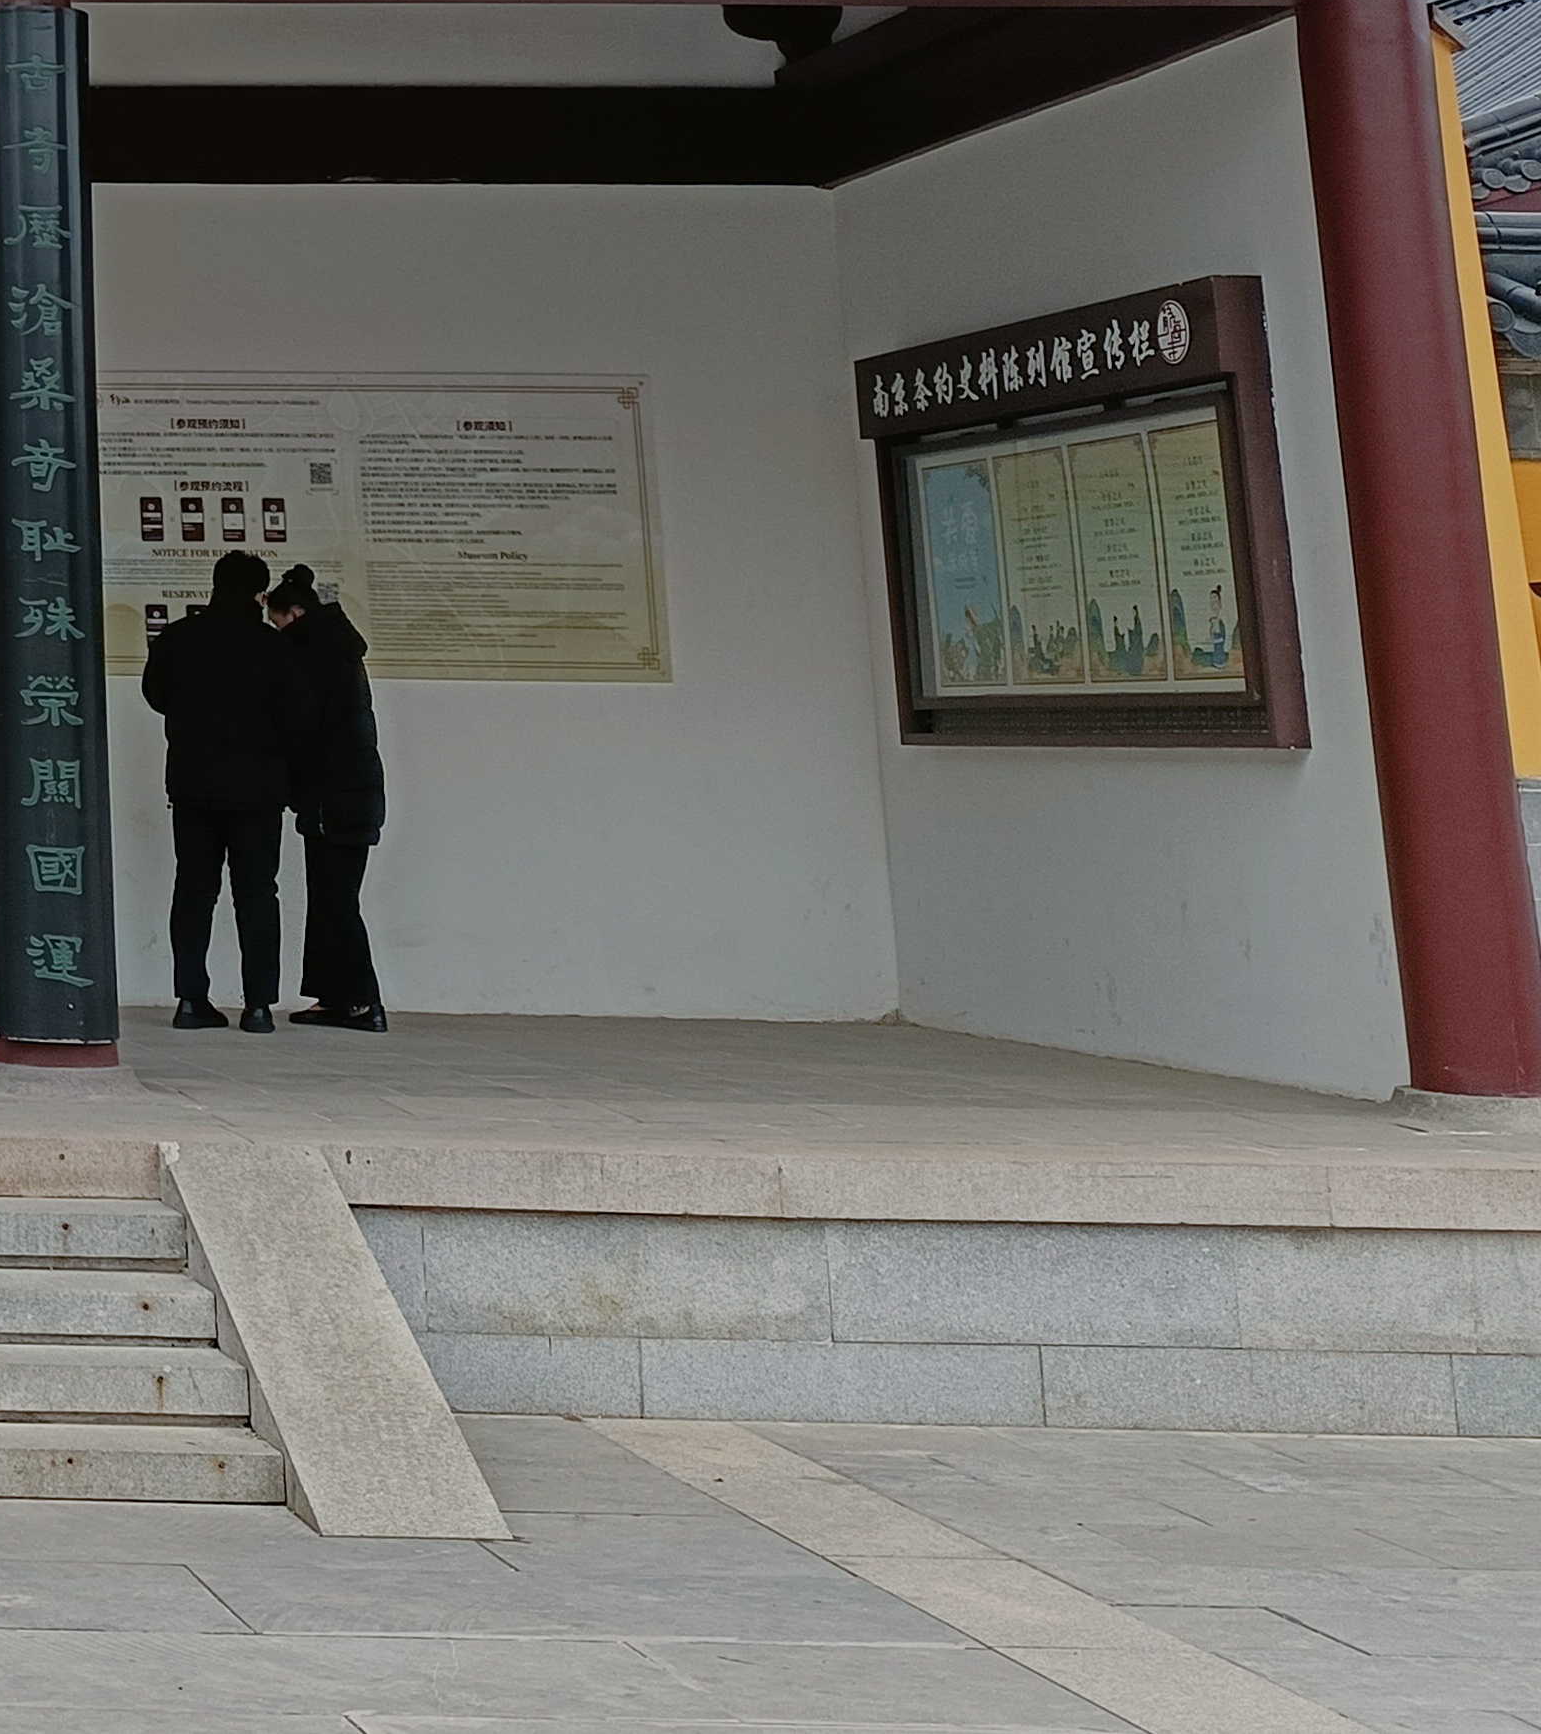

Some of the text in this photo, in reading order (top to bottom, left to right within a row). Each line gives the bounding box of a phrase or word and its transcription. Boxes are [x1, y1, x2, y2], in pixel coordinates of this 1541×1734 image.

[872, 318, 1155, 419] 南京条约史料陈列馆宣传栏
[152, 548, 186, 557] NOTICE
[188, 548, 210, 557] FOR
[457, 551, 528, 561] Museum Policy
